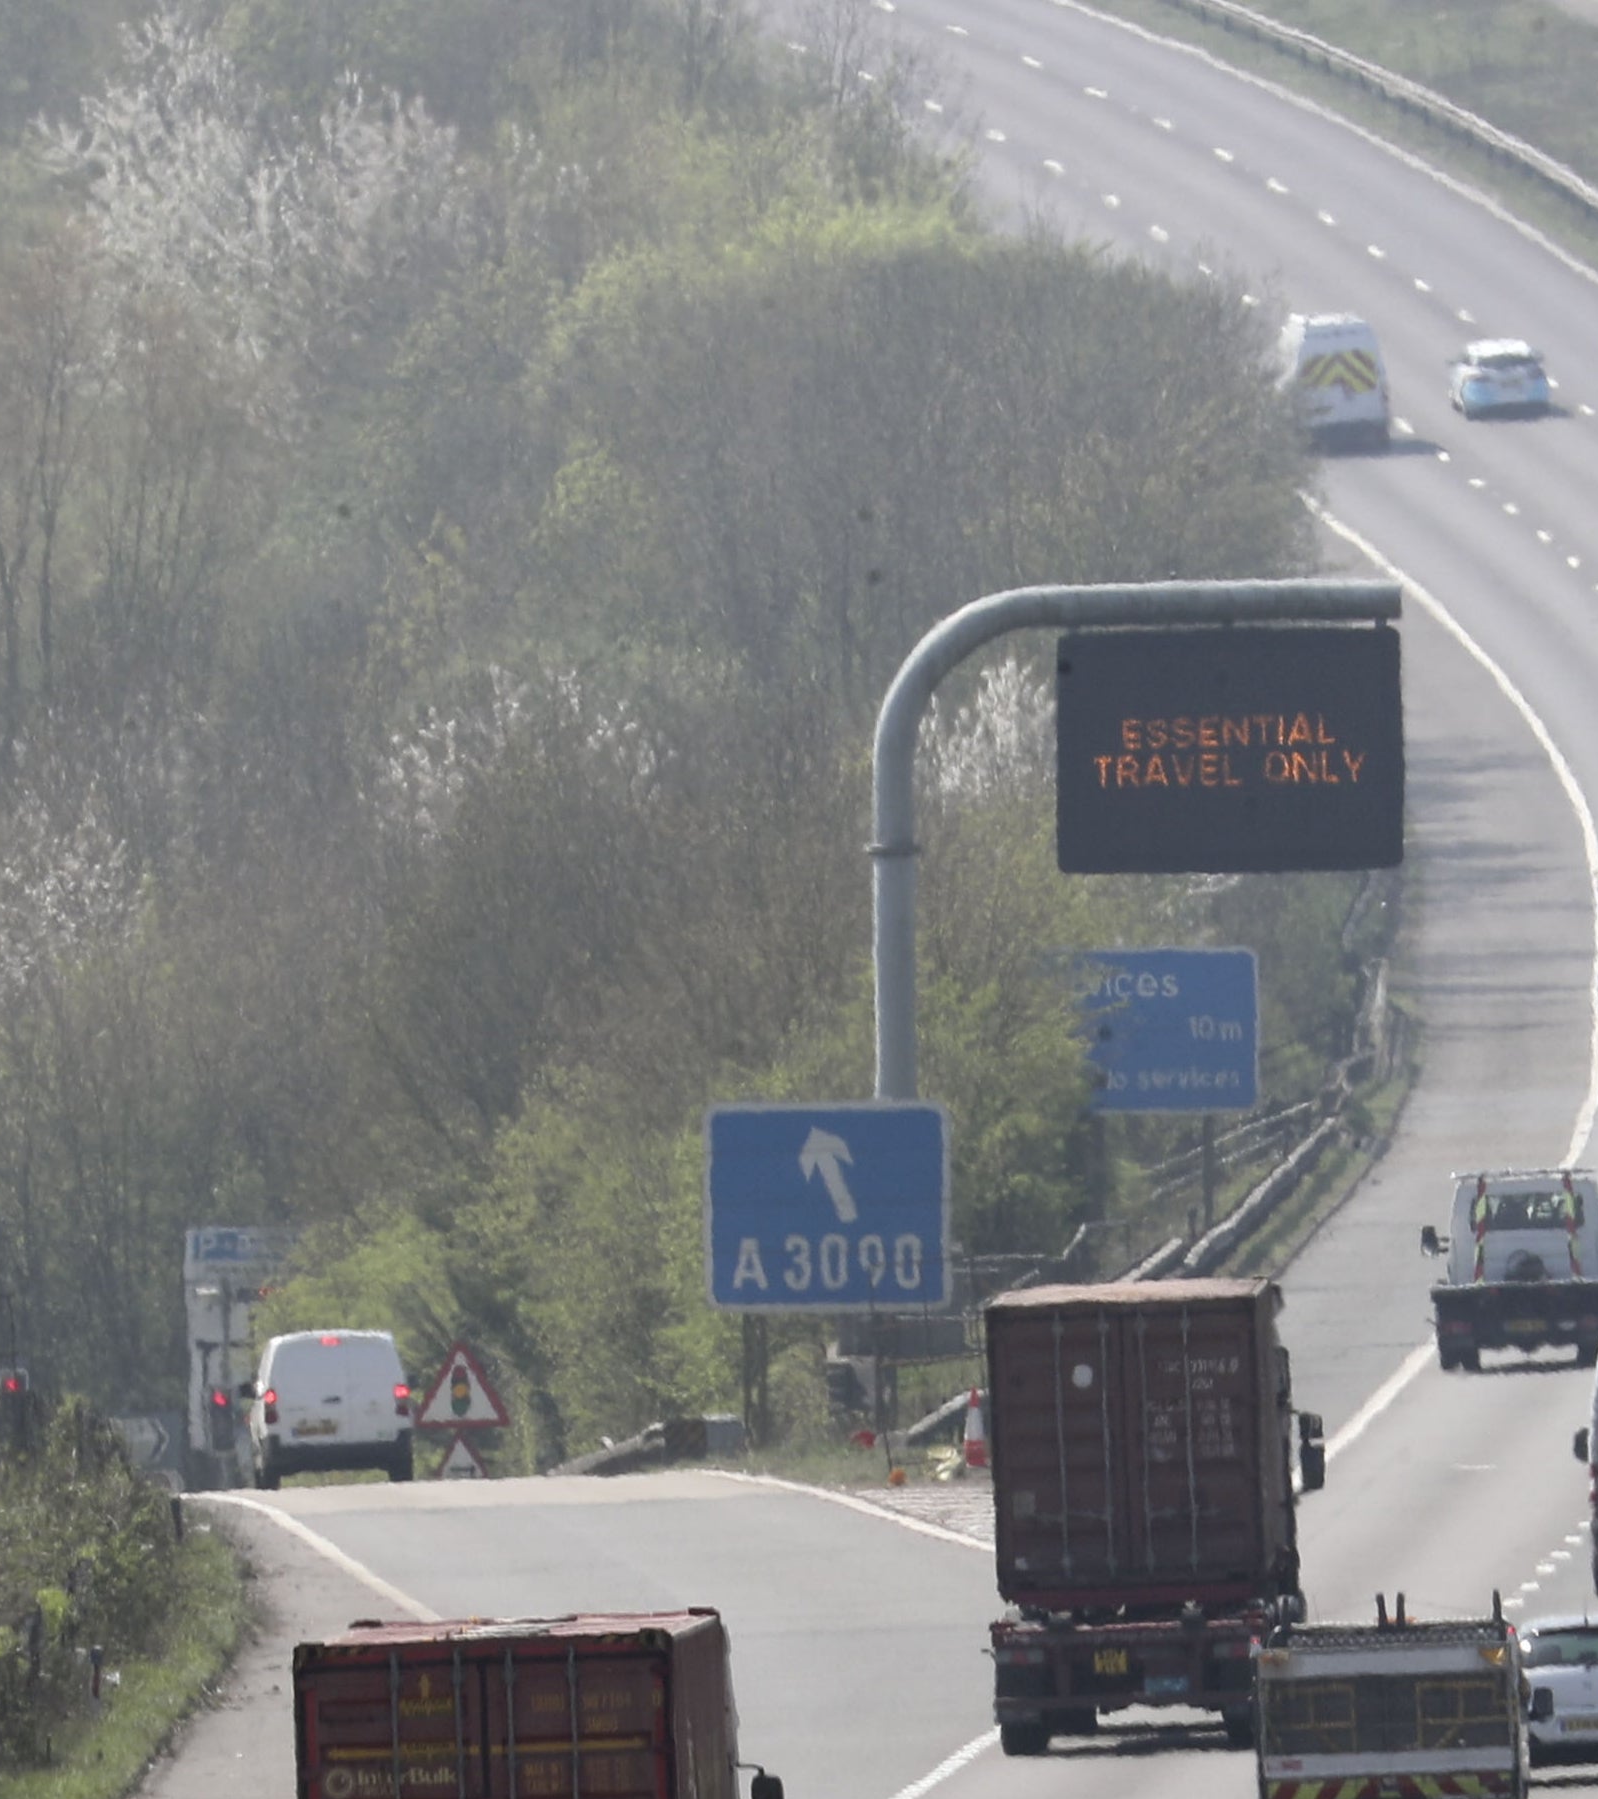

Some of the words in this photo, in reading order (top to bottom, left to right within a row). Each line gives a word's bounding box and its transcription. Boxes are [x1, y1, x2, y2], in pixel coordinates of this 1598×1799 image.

[1122, 712, 1336, 750] ESSENTIAL
[1094, 753, 1243, 788] TRAVEL
[1264, 750, 1365, 784] ONLY
[1138, 1066, 1240, 1090] services
